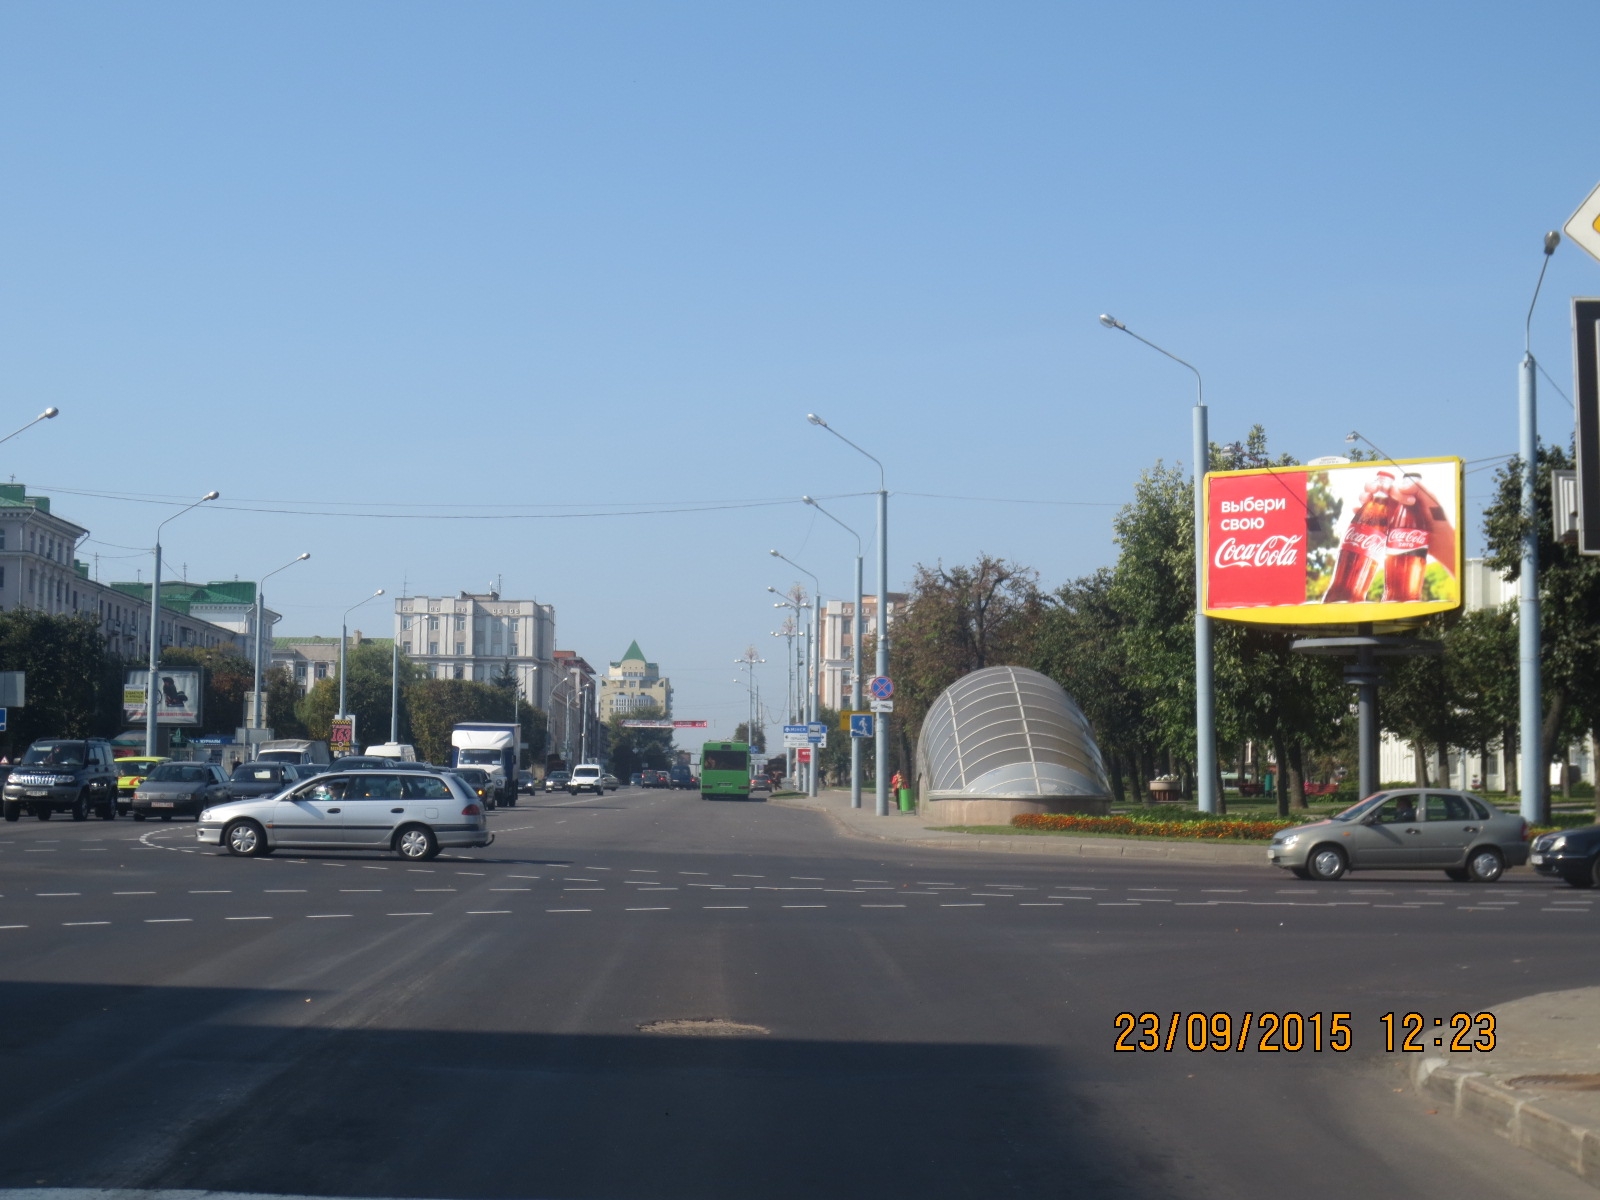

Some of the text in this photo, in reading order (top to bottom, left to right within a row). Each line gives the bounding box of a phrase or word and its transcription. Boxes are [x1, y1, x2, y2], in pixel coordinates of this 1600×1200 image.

[1221, 496, 1286, 514] выбери
[1220, 515, 1265, 531] свою
[1389, 529, 1427, 544] Coca-Cola
[1215, 535, 1303, 568] Coca-Cola
